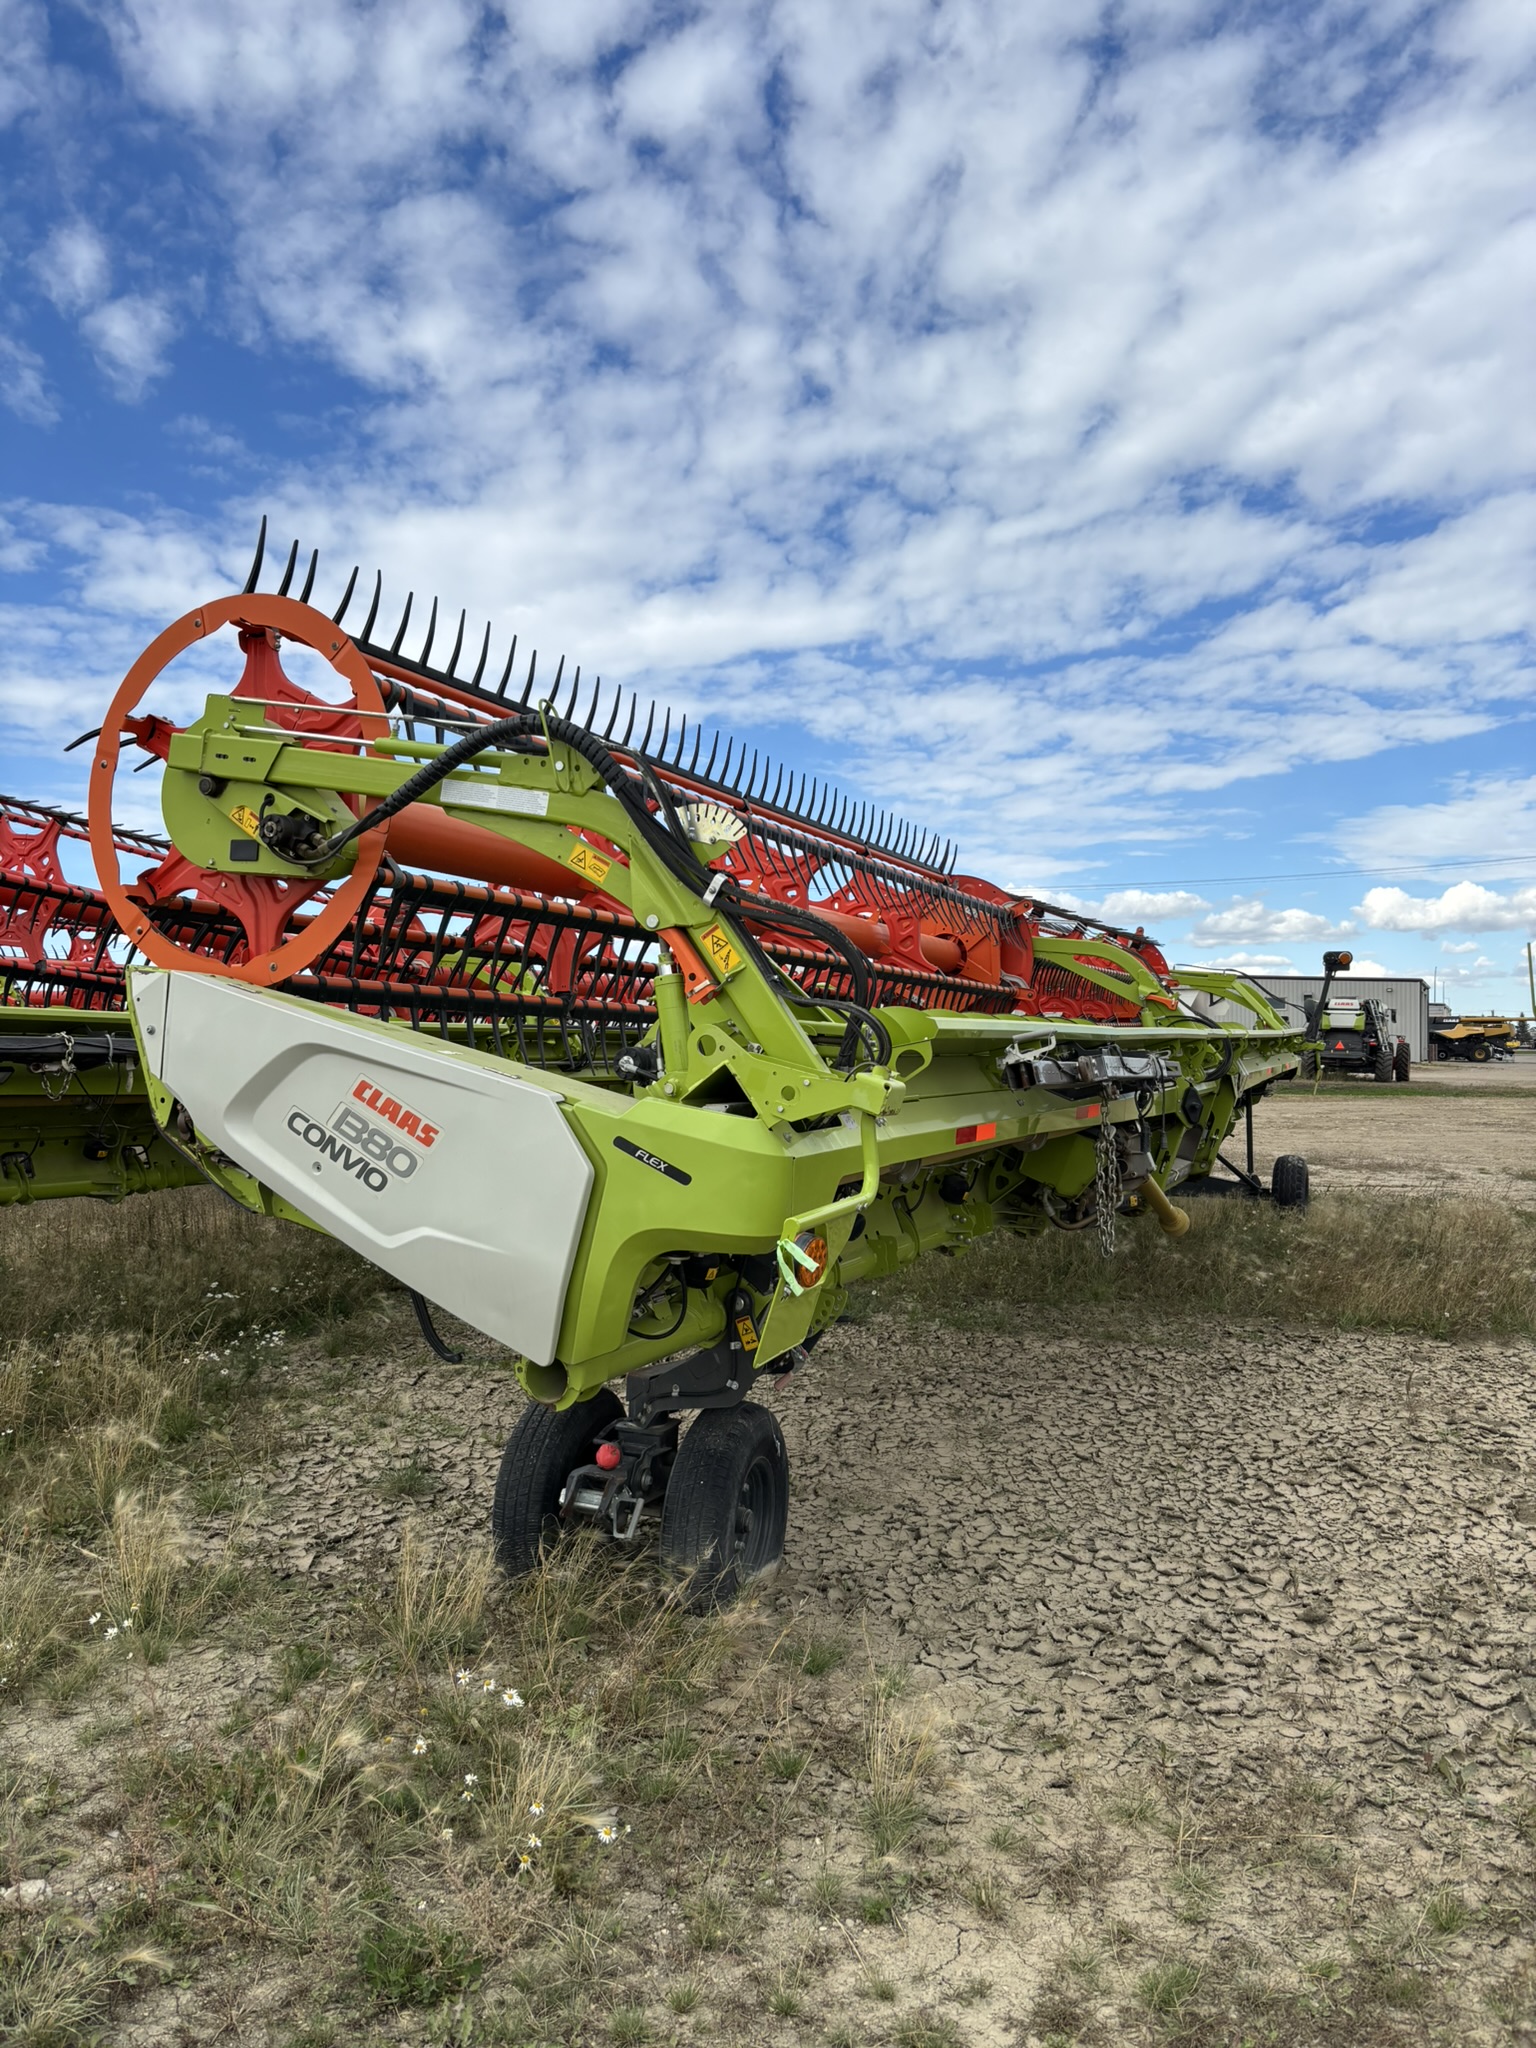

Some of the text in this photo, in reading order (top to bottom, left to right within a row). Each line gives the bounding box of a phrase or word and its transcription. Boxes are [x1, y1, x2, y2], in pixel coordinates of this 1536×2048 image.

[352, 1079, 440, 1148] CLAAS
[287, 1111, 388, 1192] CONVIO
[634, 1149, 668, 1172] FLEX
